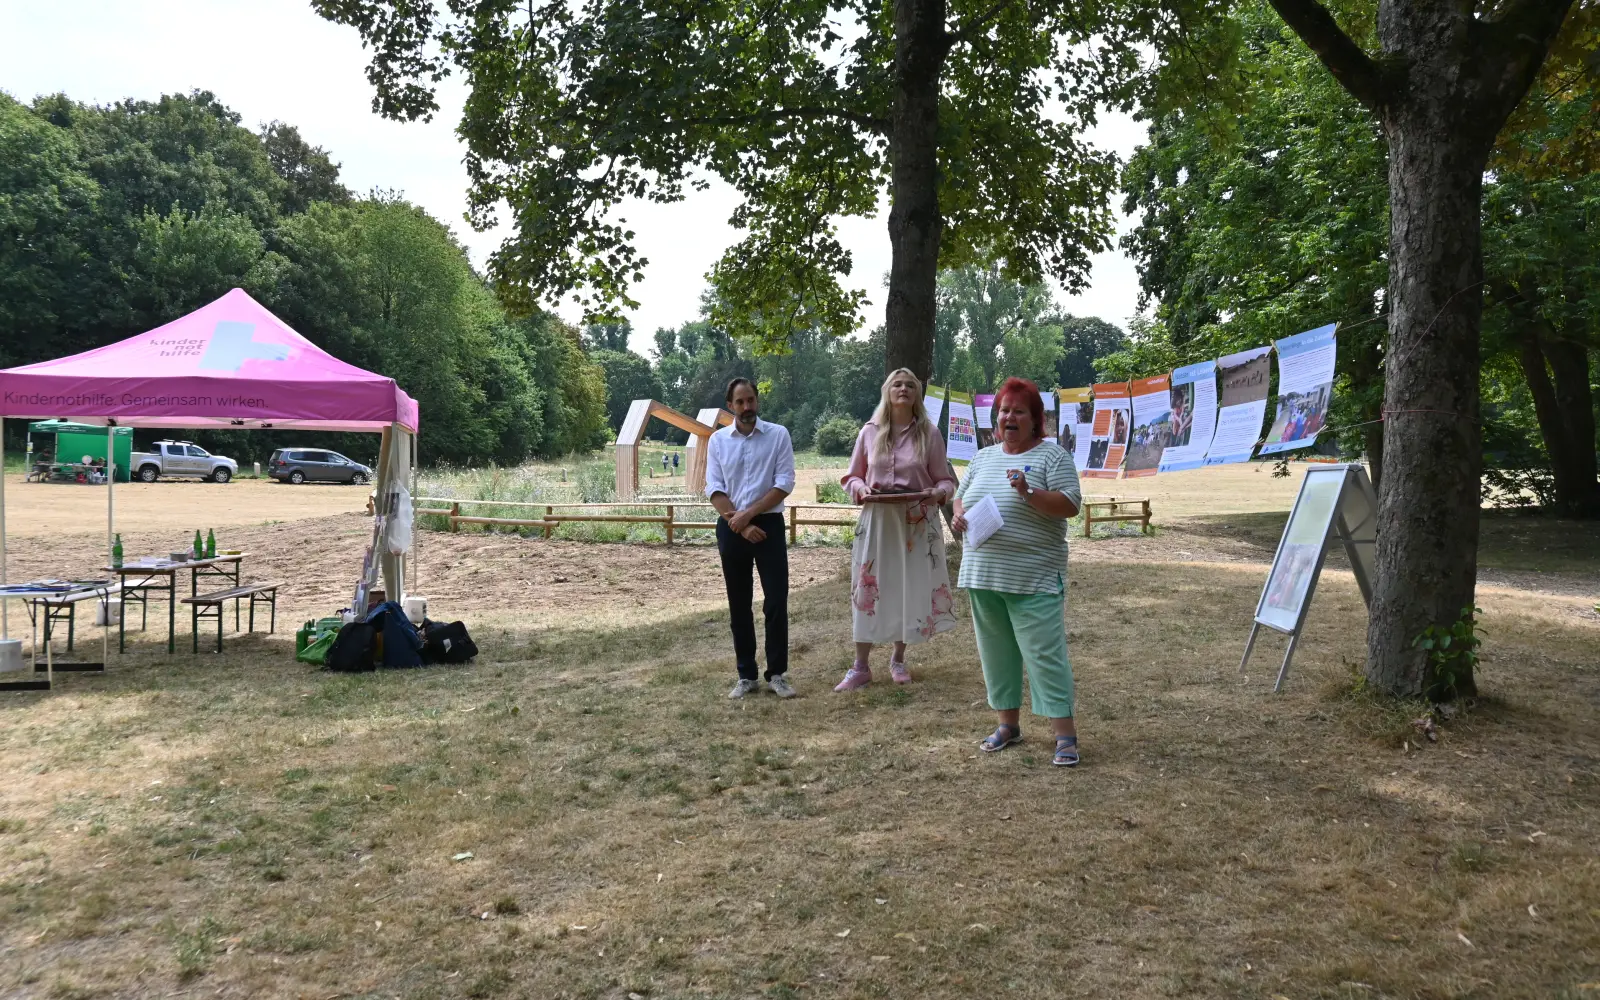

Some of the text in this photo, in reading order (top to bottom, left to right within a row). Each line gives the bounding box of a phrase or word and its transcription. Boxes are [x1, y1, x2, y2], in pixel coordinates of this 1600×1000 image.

[150, 338, 207, 346] kinder
[159, 349, 201, 357] hilfe
[4, 391, 269, 408] Kindernothilfe. Gemeinsam wirken.
